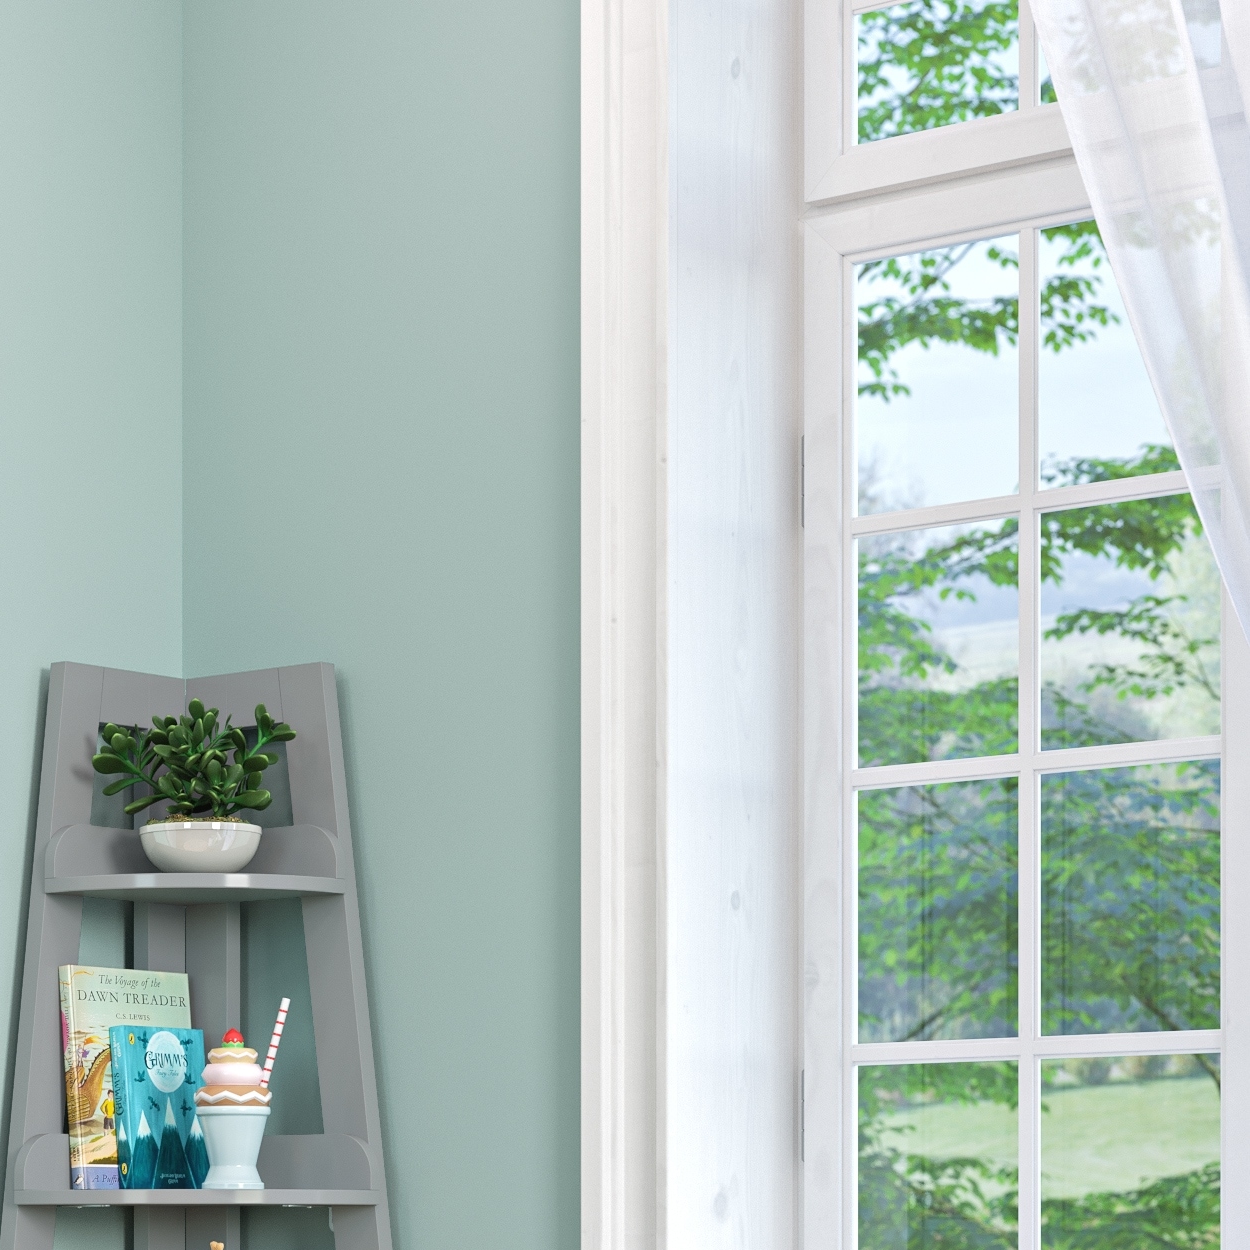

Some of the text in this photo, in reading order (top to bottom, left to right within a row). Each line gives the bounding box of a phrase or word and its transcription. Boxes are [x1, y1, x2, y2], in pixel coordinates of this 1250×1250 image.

[98, 974, 161, 990] The Voyage of the
[77, 989, 119, 1003] DAWN
[123, 992, 187, 1008] TREADER
[129, 1013, 151, 1021] LEWIS
[144, 1050, 189, 1070] GRIMM'S
[92, 1173, 100, 1183] A
